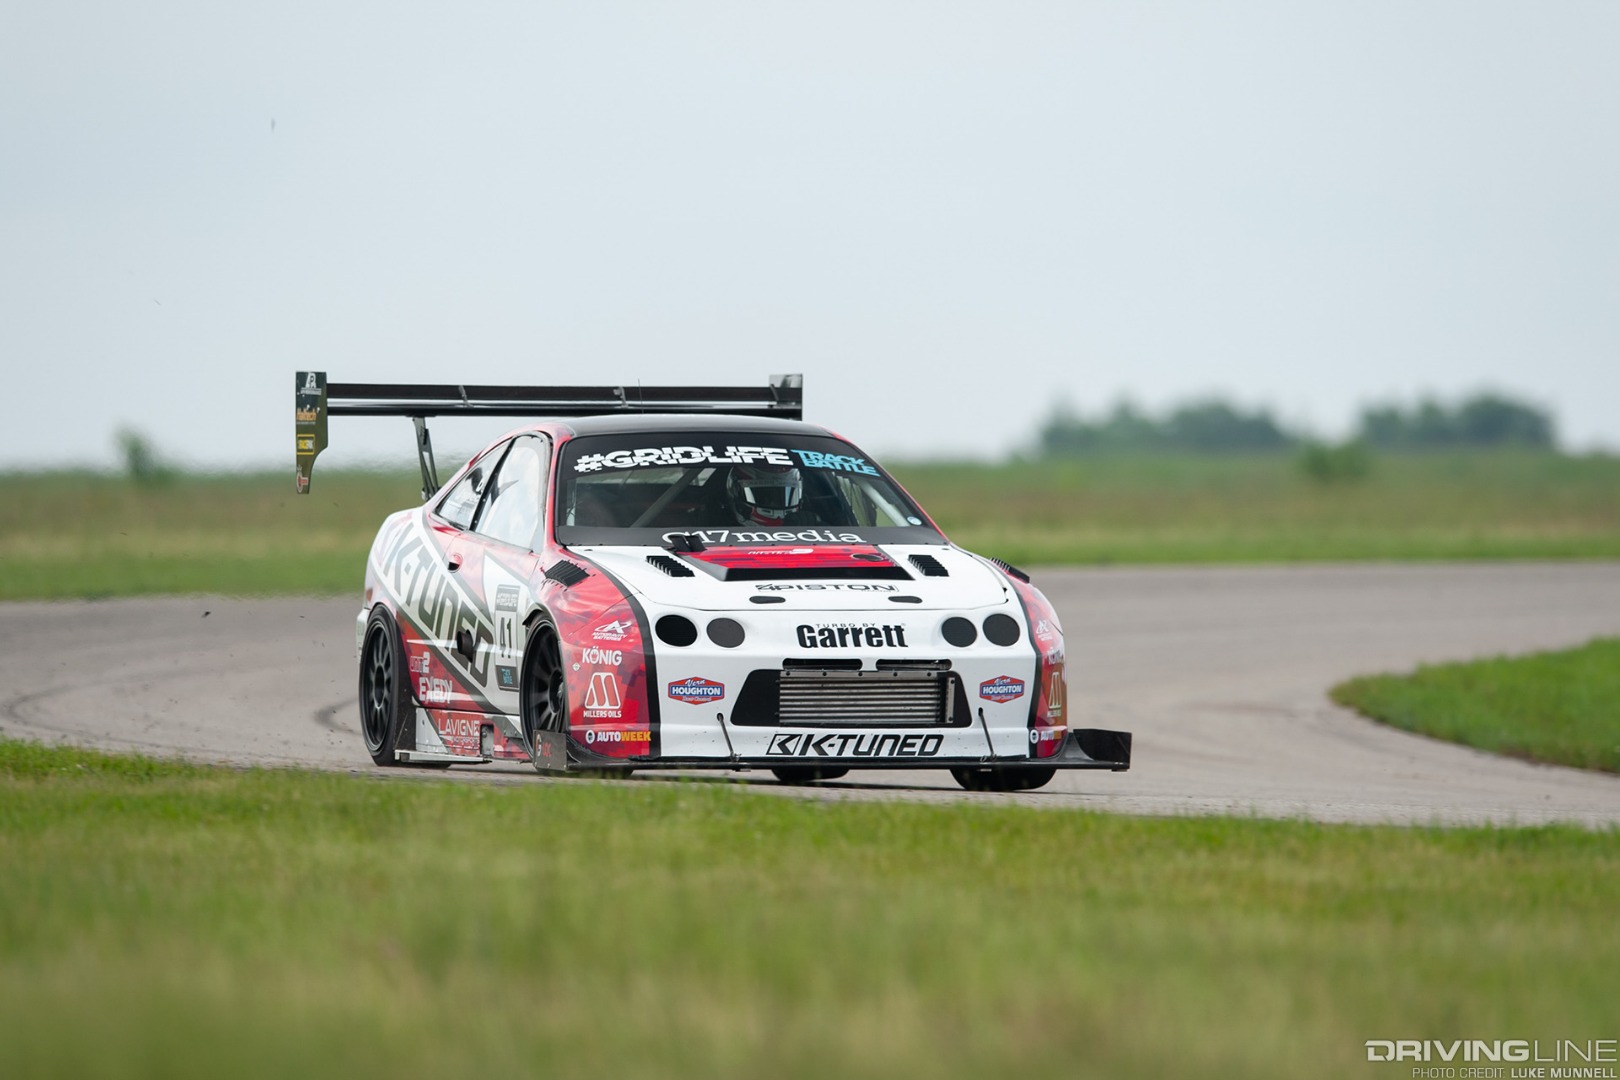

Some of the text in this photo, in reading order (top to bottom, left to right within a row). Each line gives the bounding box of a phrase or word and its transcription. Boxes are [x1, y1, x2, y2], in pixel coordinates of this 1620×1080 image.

[573, 446, 794, 474] #GRIDLIFE
[791, 450, 865, 467] TRACK
[802, 459, 881, 477] BATTLE
[796, 624, 909, 649] Garrett
[582, 645, 623, 666] KÖNIG
[419, 677, 453, 704] EXEDY
[671, 686, 721, 696] HOUGHTON
[982, 684, 1023, 695] HOUGHTON
[583, 710, 607, 718] MILLERS
[438, 718, 480, 737] LAVIGNE
[597, 731, 652, 742] AUTOWEEK
[798, 733, 945, 757] K-TUNED
